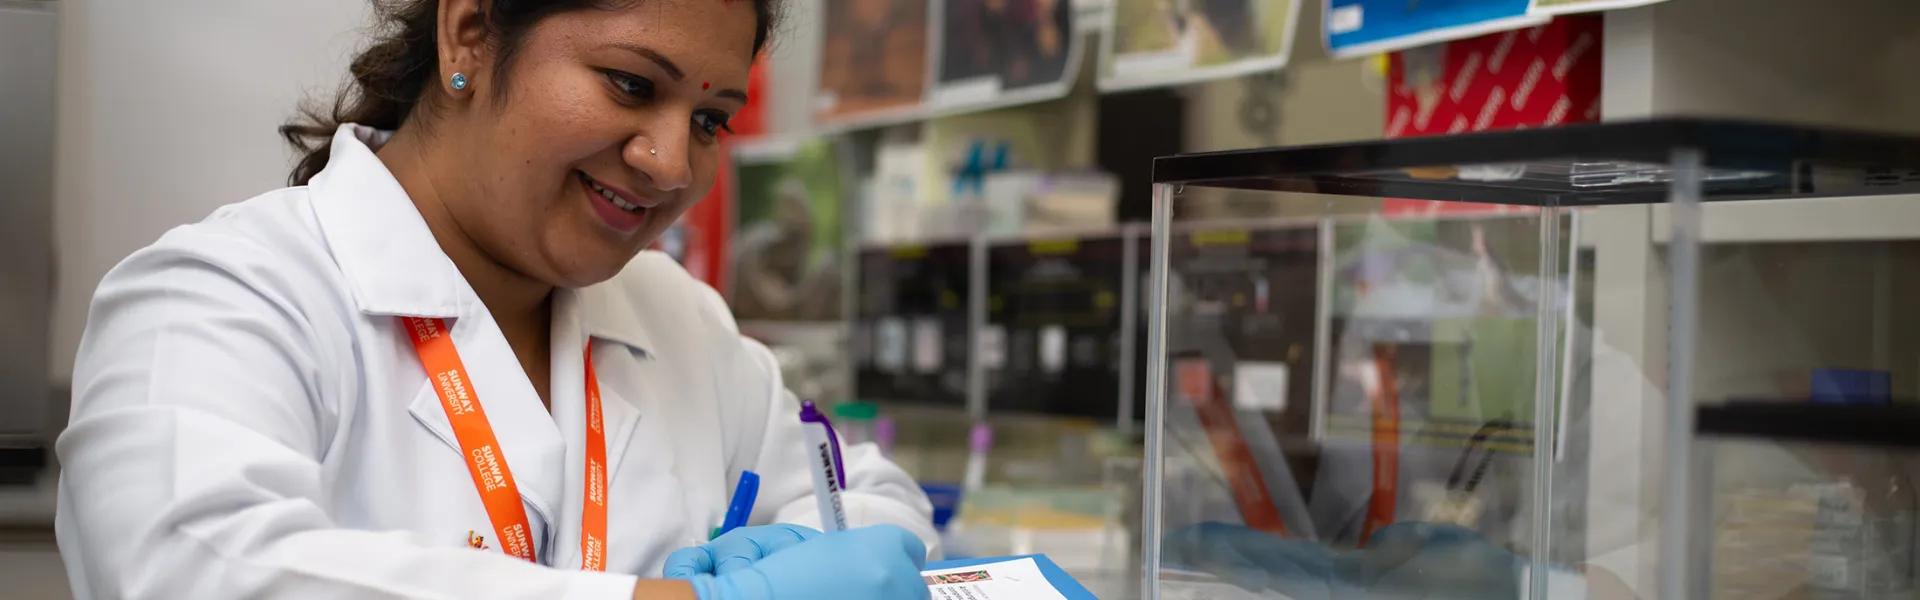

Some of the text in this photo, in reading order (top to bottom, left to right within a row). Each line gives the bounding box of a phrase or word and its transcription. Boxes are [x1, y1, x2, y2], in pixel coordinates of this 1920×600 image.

[437, 371, 465, 416] UNIVERSITY
[447, 369, 474, 414] SUNWAY
[471, 448, 497, 492] COLLEGE
[481, 445, 507, 489] SUNWAY
[588, 458, 598, 503] SUNWAY
[819, 442, 838, 493] SUNWAY
[512, 523, 531, 562] SUNW
[584, 534, 596, 572] UNWAY
[592, 537, 602, 575] OLLEGE
